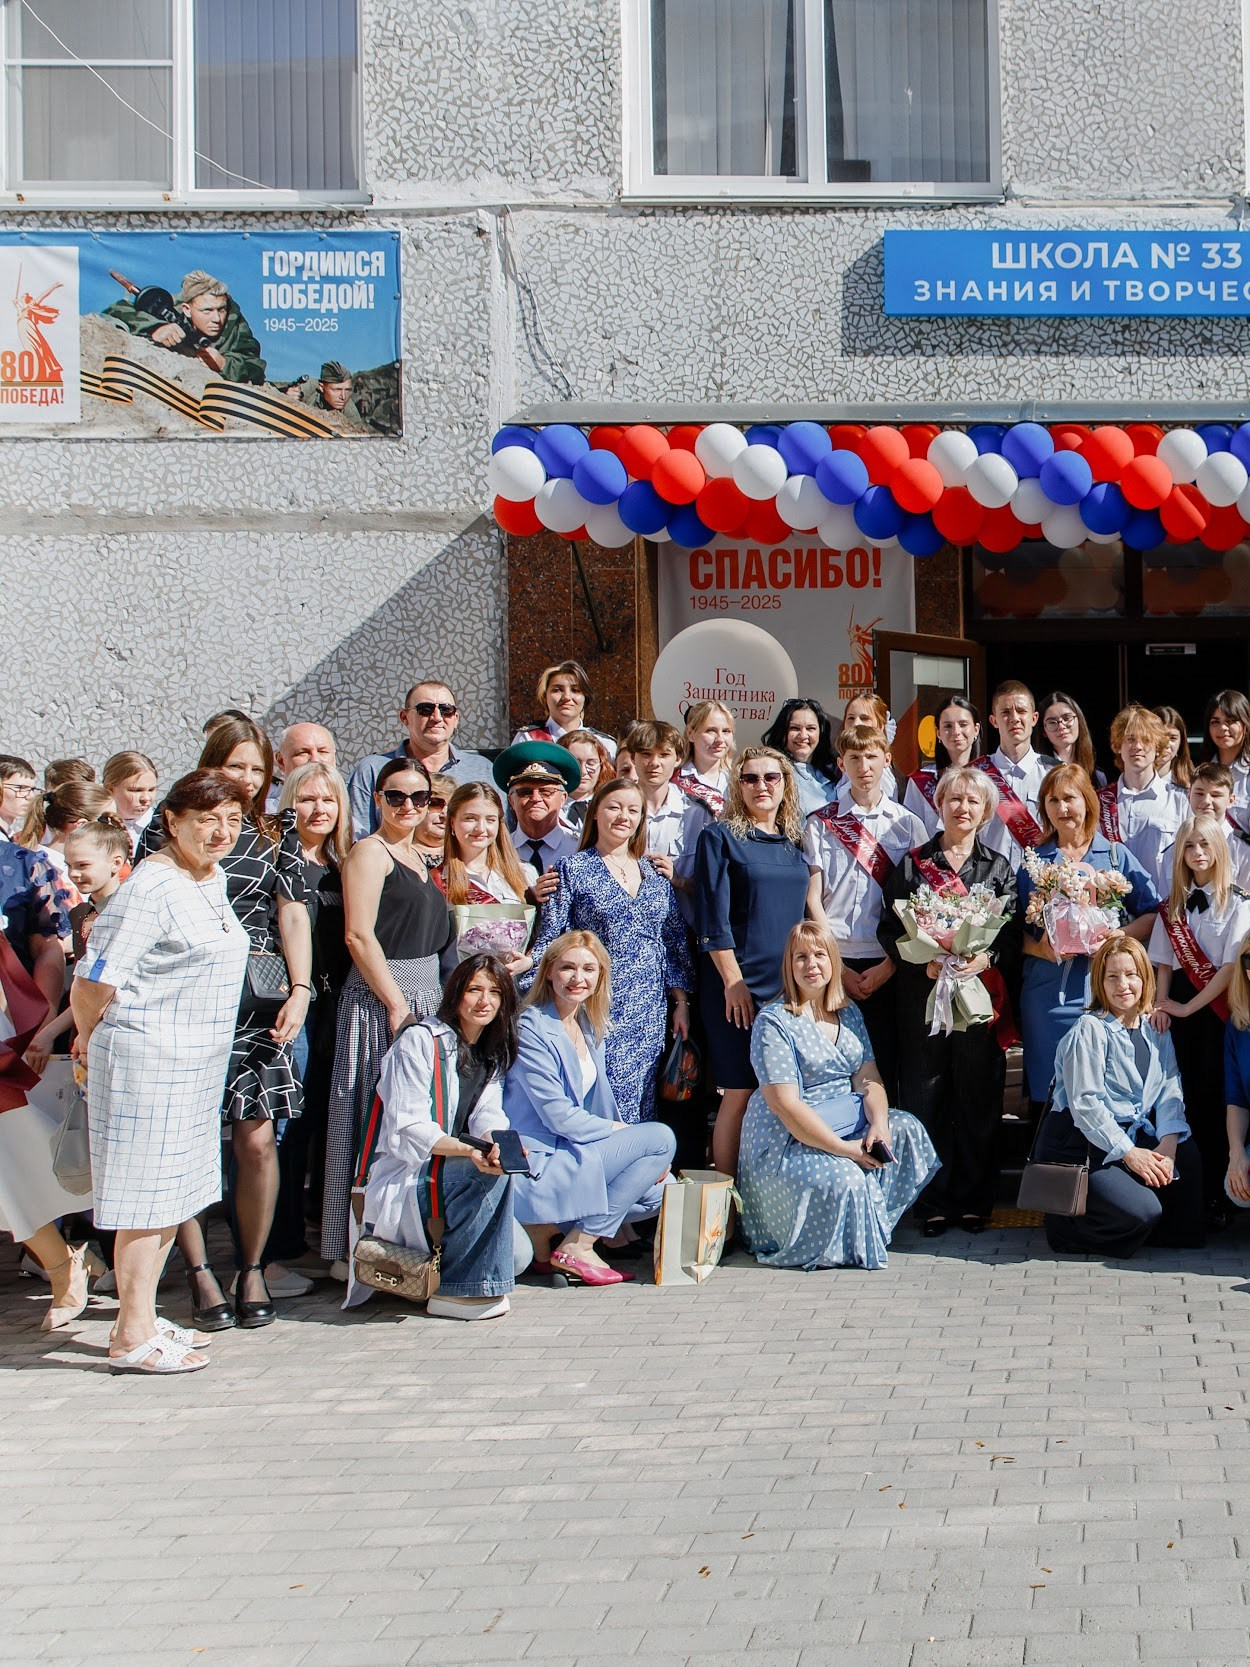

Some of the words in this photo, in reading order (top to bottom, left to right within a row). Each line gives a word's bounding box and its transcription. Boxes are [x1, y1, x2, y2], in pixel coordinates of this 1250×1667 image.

[262, 250, 386, 281] ГОРДИМСЯ
[991, 242, 1139, 270] ШКОЛА
[1151, 242, 1191, 270] №
[1201, 242, 1243, 269] 33
[262, 280, 375, 313] ПОБЕДОЙ!
[913, 279, 1055, 302] ЗНАНИЯ
[1071, 279, 1091, 302] И
[264, 317, 339, 332] 1945–2025
[1, 350, 34, 382] 80
[0, 388, 64, 407] ПОБЕДА!
[689, 547, 882, 590] СПАСИБО!
[715, 667, 746, 687] Год
[838, 663, 865, 685] 80
[682, 681, 775, 703] Защитника
